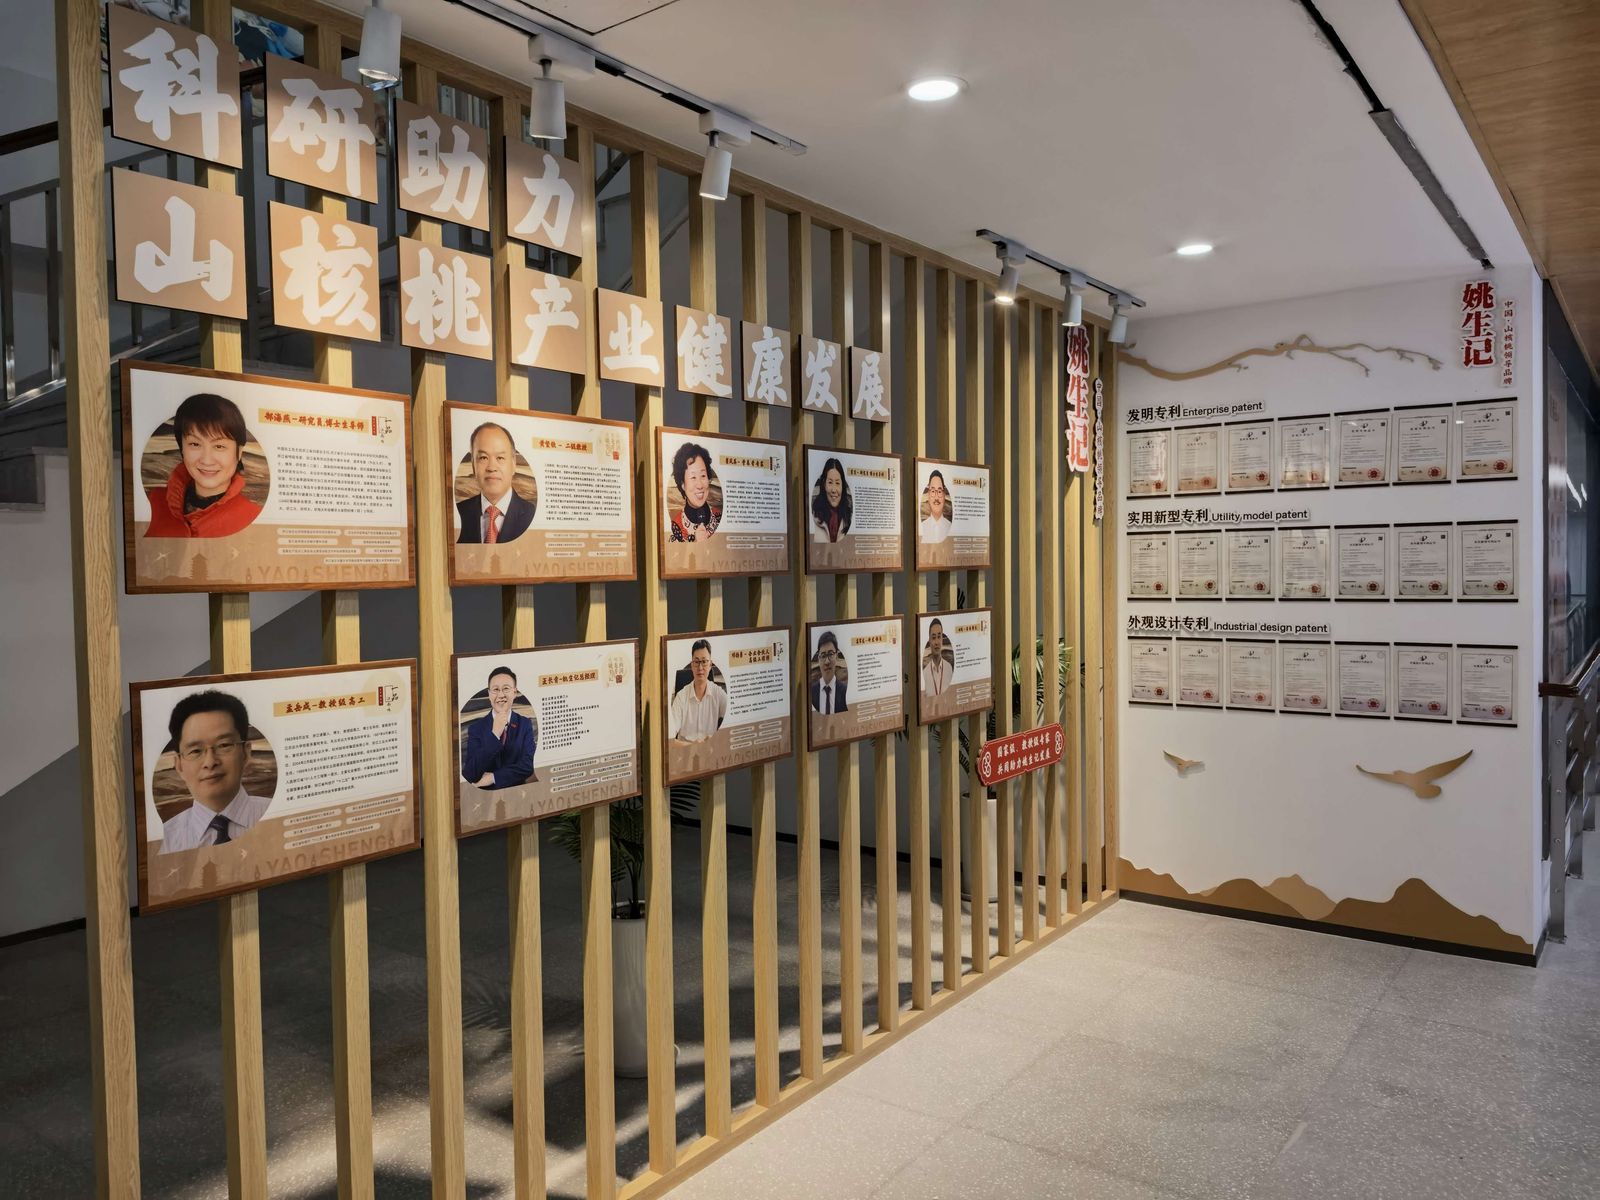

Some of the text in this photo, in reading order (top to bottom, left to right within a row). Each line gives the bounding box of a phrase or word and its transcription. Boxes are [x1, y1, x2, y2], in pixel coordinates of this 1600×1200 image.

[119, 27, 576, 249] 科研助力
[134, 195, 890, 419] 山核桃产业健康发展
[1462, 282, 1494, 367] 姚生记
[1068, 328, 1089, 467] 姚生记
[1127, 402, 1263, 422] 发明专利 Enterprise patent
[1127, 509, 1308, 525] 实用新型专利 Utility model patent
[1128, 615, 1328, 636] 外观设计专利 Industrial design patent
